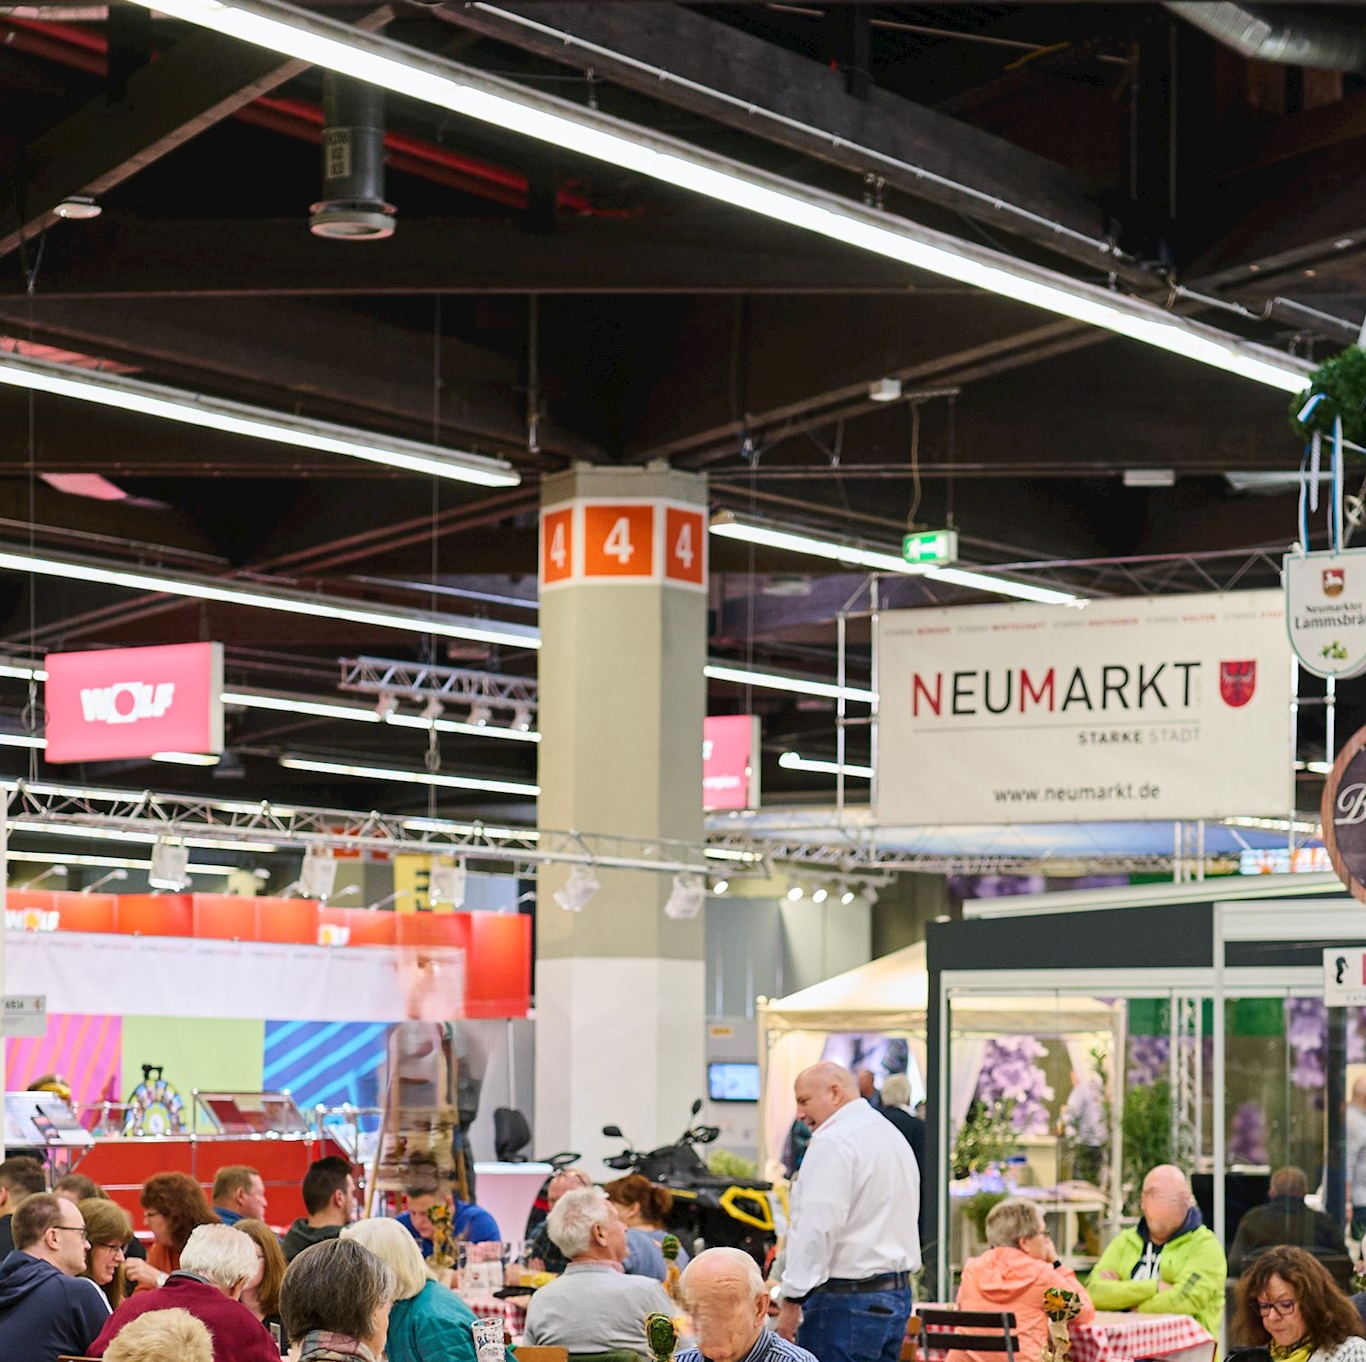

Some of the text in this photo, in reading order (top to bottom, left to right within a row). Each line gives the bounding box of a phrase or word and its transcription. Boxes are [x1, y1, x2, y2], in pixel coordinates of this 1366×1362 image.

[550, 523, 566, 569] 4
[603, 517, 634, 565] 4
[675, 523, 694, 569] 4
[80, 681, 175, 724] WOLF
[911, 662, 1202, 718] NEUMARKT
[1079, 727, 1202, 746] STARKE STADT
[993, 781, 1161, 803] www.neumarkt.de
